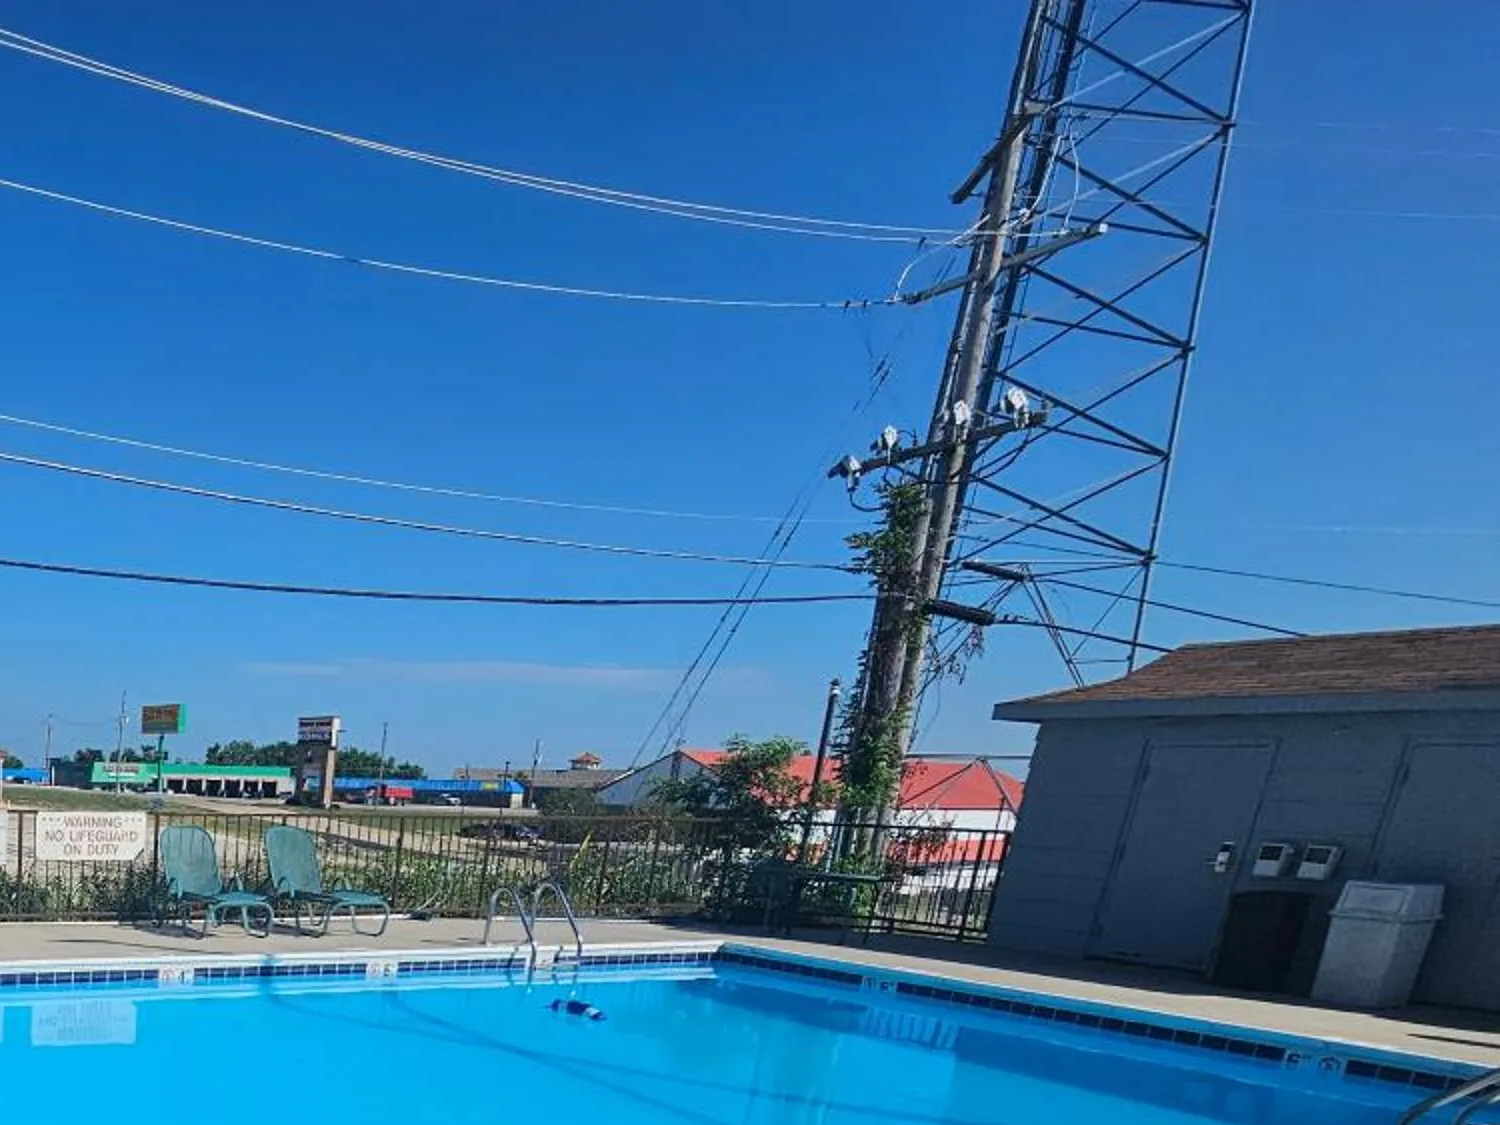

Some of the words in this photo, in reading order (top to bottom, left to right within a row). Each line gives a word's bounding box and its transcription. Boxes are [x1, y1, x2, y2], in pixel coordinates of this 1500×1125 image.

[64, 816, 123, 828] WARNING
[45, 829, 64, 841] NO
[69, 830, 138, 842] LIFEGUARD
[64, 843, 80, 855] ON
[87, 844, 119, 855] DUTY
